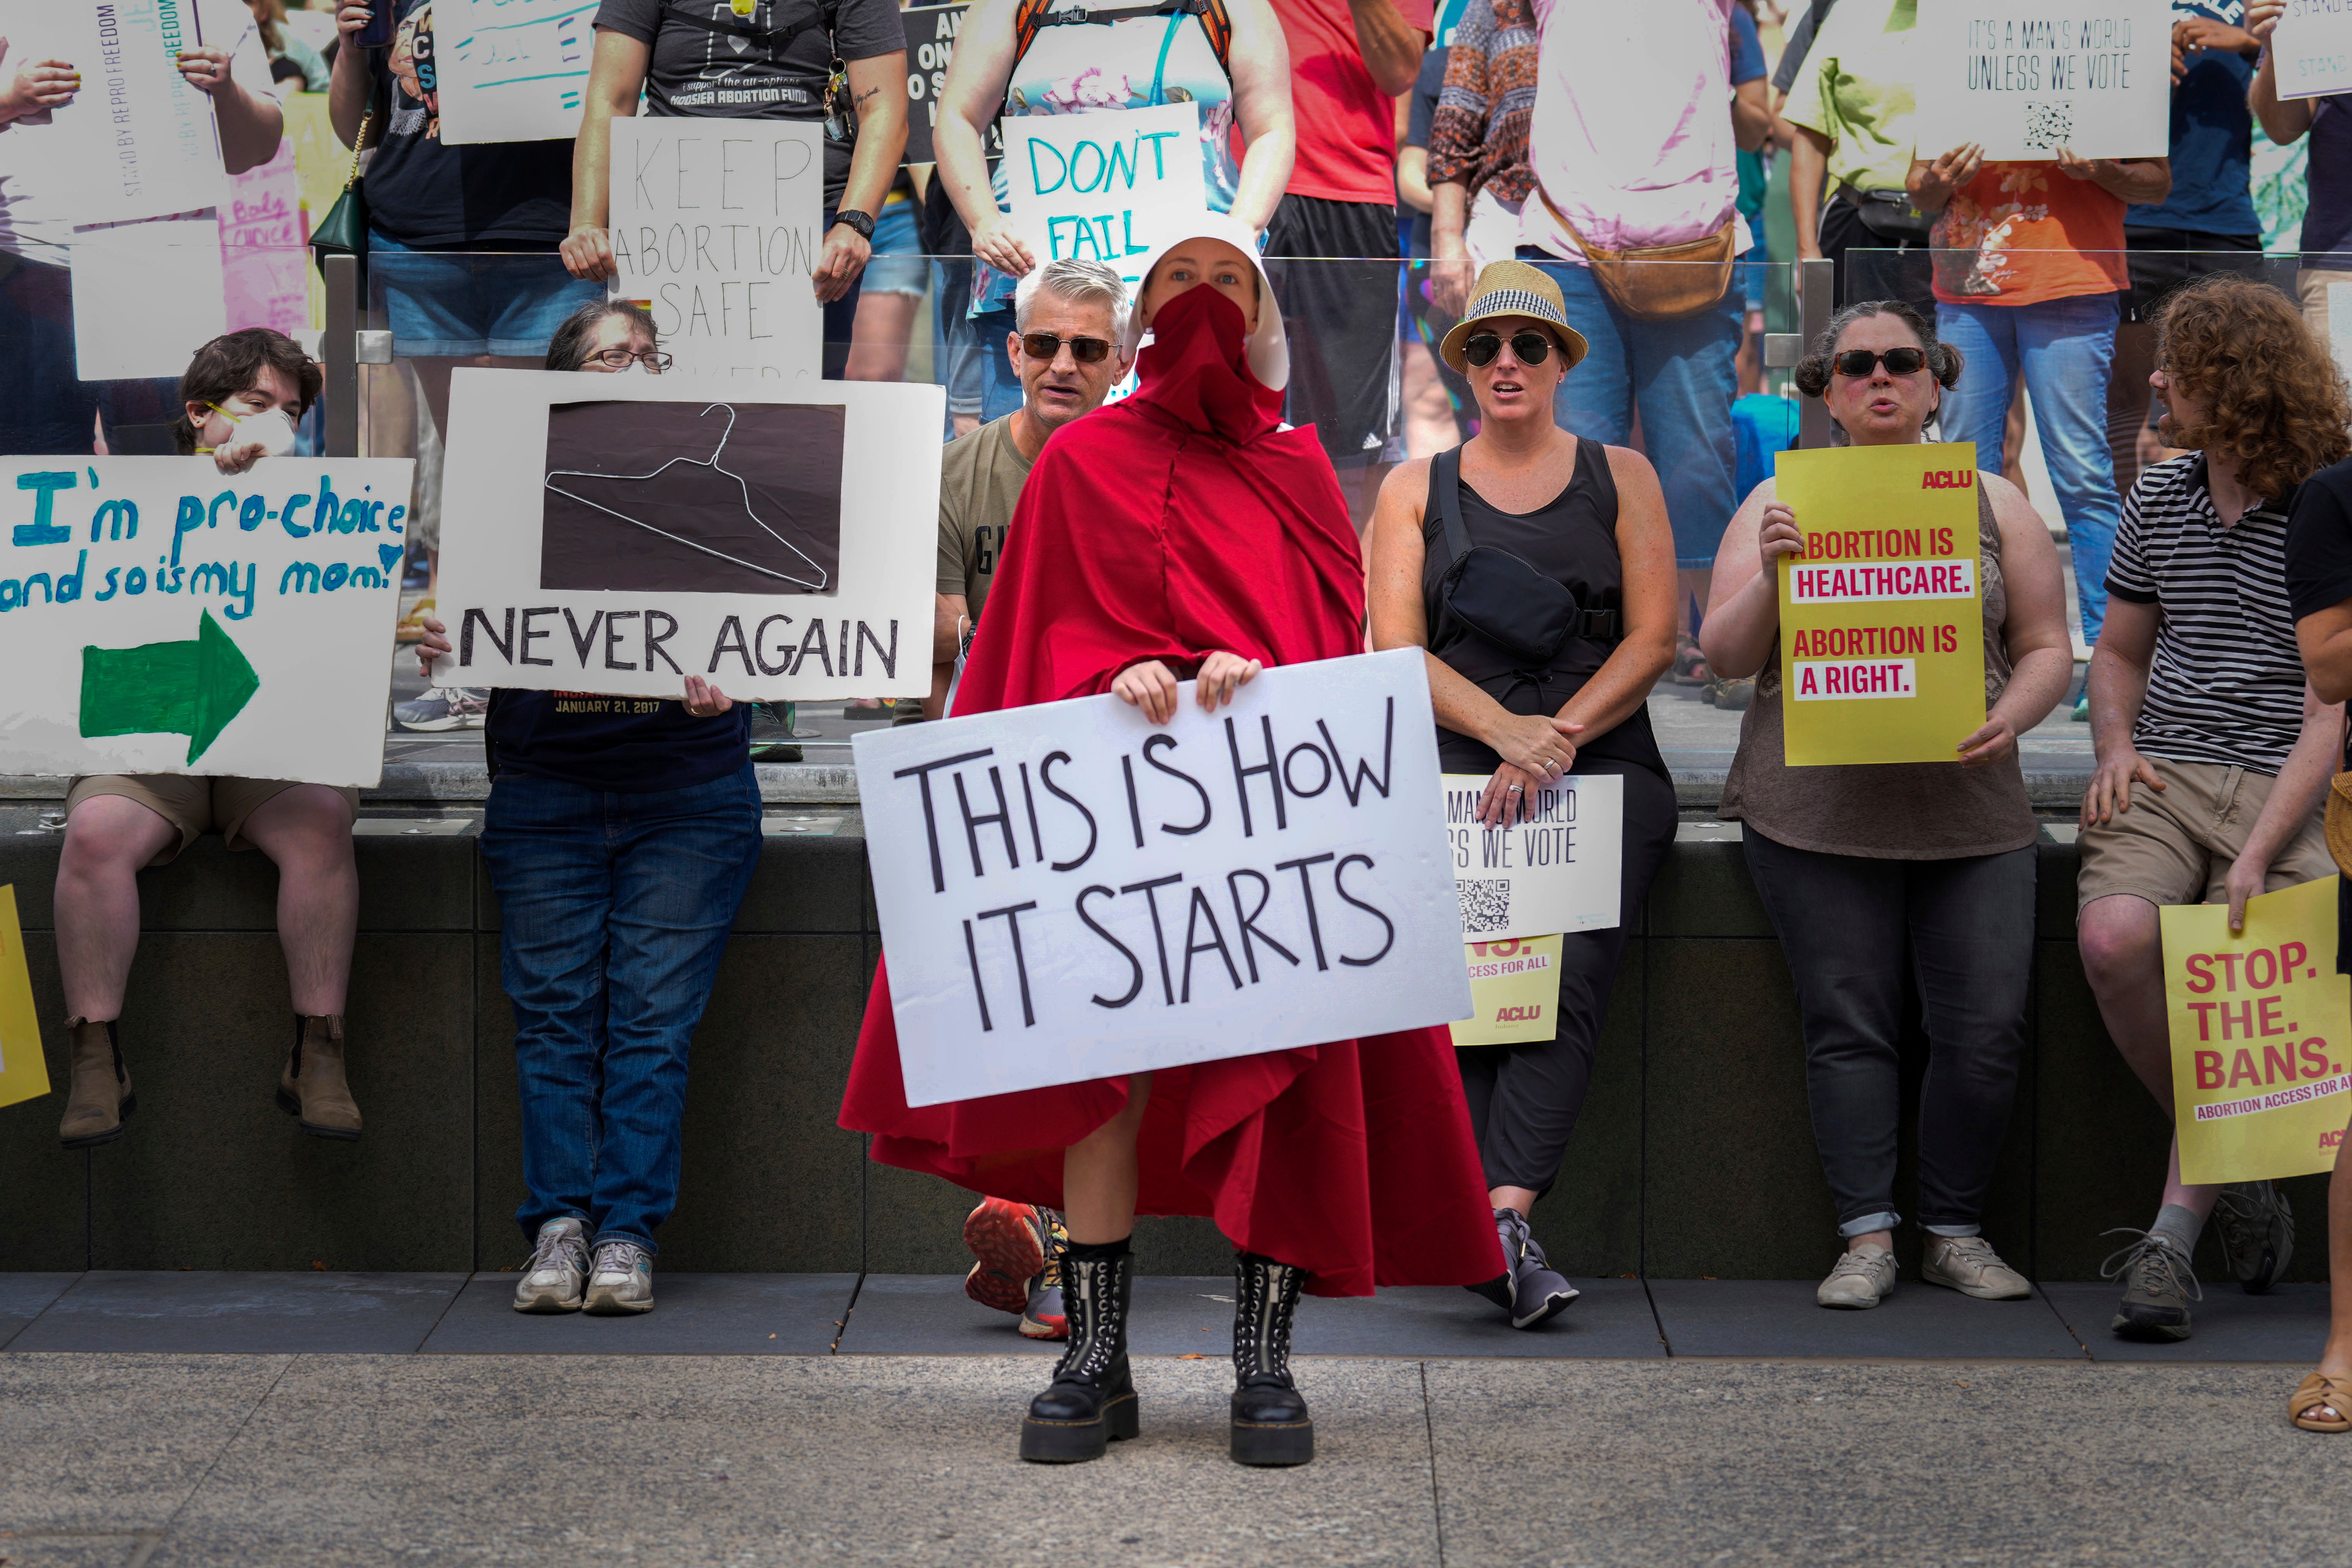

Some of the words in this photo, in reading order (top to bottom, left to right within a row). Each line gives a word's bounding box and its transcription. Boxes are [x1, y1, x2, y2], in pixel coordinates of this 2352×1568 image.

[97, 5, 123, 73] FREEDOM
[1969, 20, 1996, 50] IT'S
[2005, 21, 2013, 50] A
[2022, 20, 2071, 50] MAN'S
[2080, 18, 2131, 49] WORLD
[918, 41, 953, 70] ON
[1968, 55, 2040, 90] UNLESS
[2051, 55, 2076, 90] WE
[2087, 53, 2131, 90] VOTE
[107, 78, 131, 123] REPRO
[670, 91, 714, 105] HOOSIER
[718, 89, 779, 103] ABORTION
[781, 89, 807, 103] FUND
[687, 78, 721, 92] support
[724, 78, 741, 87] the
[742, 76, 800, 88] all-options
[116, 129, 134, 146] BY
[636, 138, 811, 216] KEEP
[1028, 129, 1180, 196] DON'T
[614, 223, 813, 276] ABORTION
[1048, 210, 1151, 261] FAIL
[657, 281, 773, 340] SAFE
[1922, 470, 1972, 490] ACLU
[12, 466, 139, 546] I'm
[170, 474, 406, 568] pro-choice
[1930, 528, 1954, 556] IS
[0, 549, 88, 612] and
[95, 566, 147, 602] so
[1797, 565, 1971, 598] HEALTHCARE.
[459, 606, 684, 675] NEVER
[707, 613, 898, 679] AGAIN
[1793, 626, 1924, 657] ABORTION
[1934, 624, 1958, 654] IS
[1800, 667, 1818, 695] A
[1826, 664, 1910, 695] RIGHT.
[556, 700, 610, 713] JANUARY
[614, 701, 630, 714] 21,
[634, 701, 660, 714] 2017
[894, 747, 1098, 894] THIS
[1121, 733, 1212, 849] IS
[1223, 697, 1394, 838] HOW
[1482, 829, 1513, 868] WE
[1524, 826, 1577, 867] VOTE
[963, 900, 1037, 1032] IT
[1076, 853, 1395, 1009] STARTS
[1501, 960, 1524, 974] FOR
[1527, 956, 1548, 970] ALL
[2185, 941, 2317, 994] STOP.
[1496, 1005, 1541, 1022] ACLU
[2187, 995, 2298, 1042] THE.
[2194, 1037, 2342, 1090] BANS.
[2197, 1094, 2262, 1120] ABORTION
[2264, 1087, 2311, 1110] ACCESS
[2313, 1080, 2338, 1097] FOR
[2319, 1129, 2346, 1148] AC
